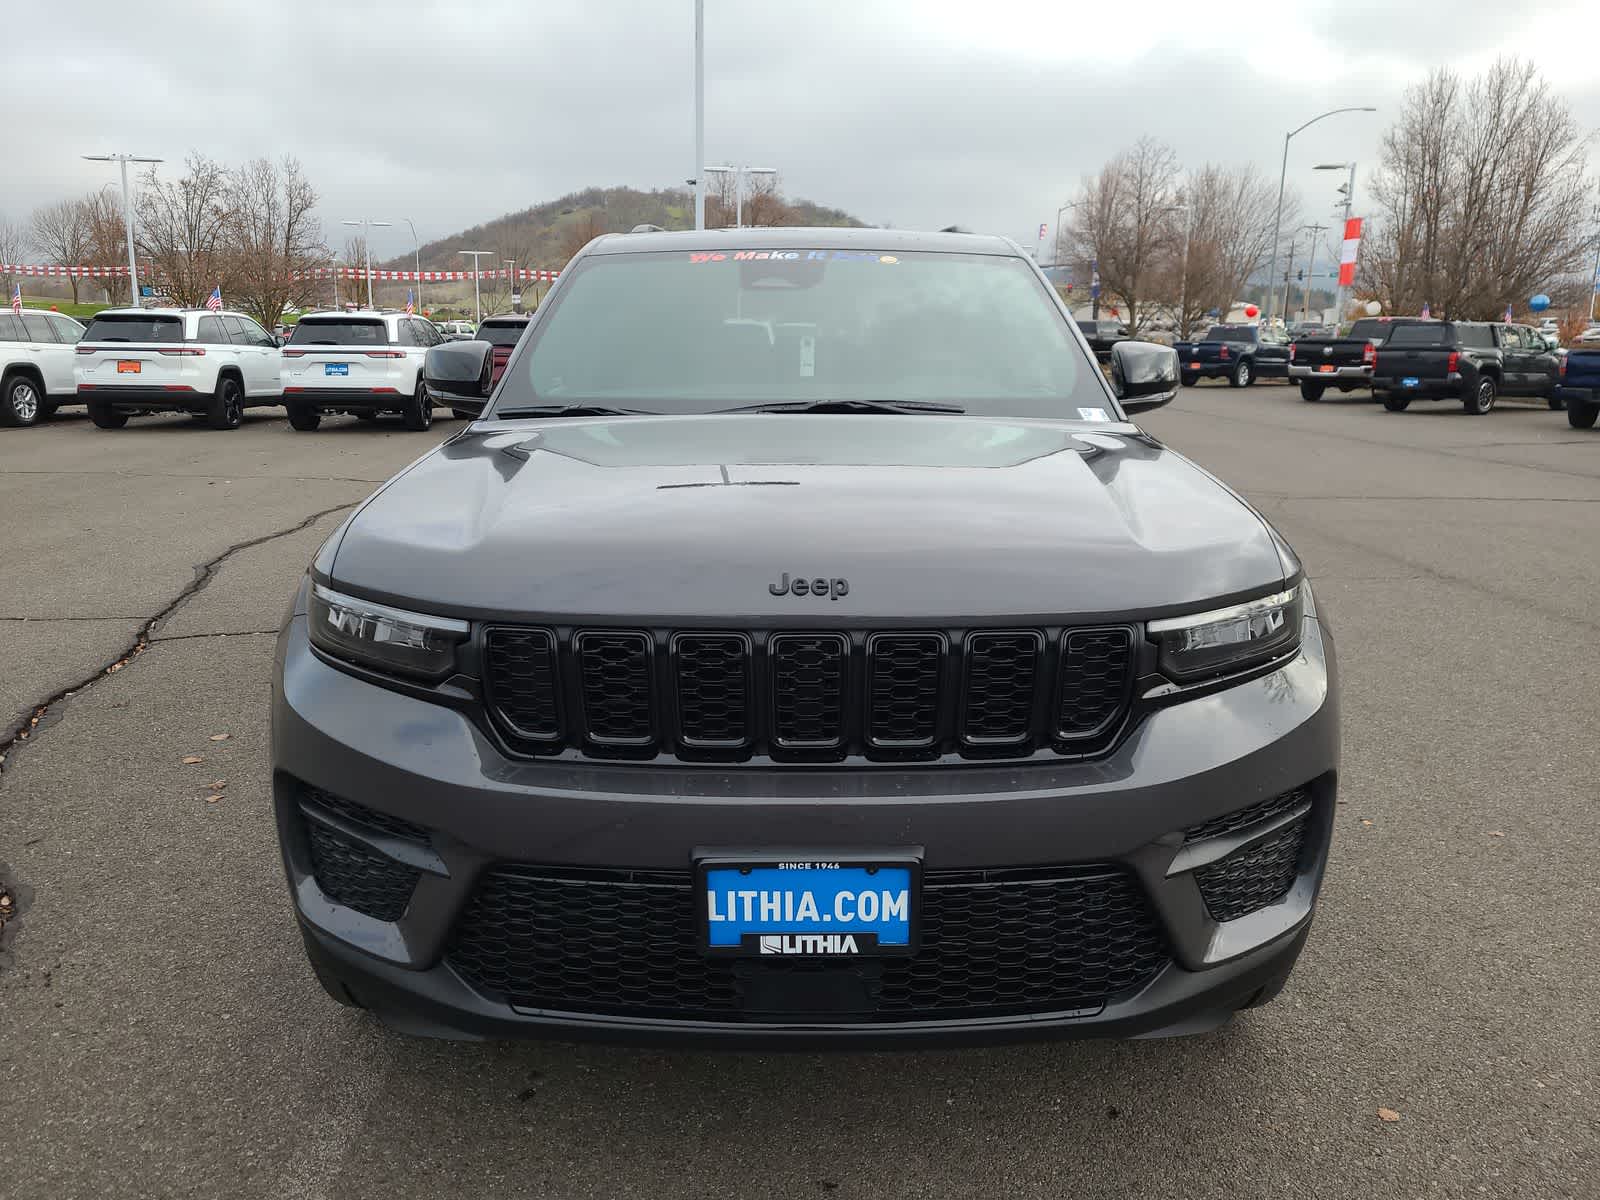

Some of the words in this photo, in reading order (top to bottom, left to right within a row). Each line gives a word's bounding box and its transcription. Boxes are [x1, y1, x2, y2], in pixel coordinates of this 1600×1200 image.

[733, 250, 800, 261] Make
[768, 572, 849, 601] Jeep
[778, 862, 811, 870] SINCE
[815, 862, 840, 870] 1946
[707, 889, 909, 922] LITHIA.COM
[782, 934, 859, 954] LITHIA
